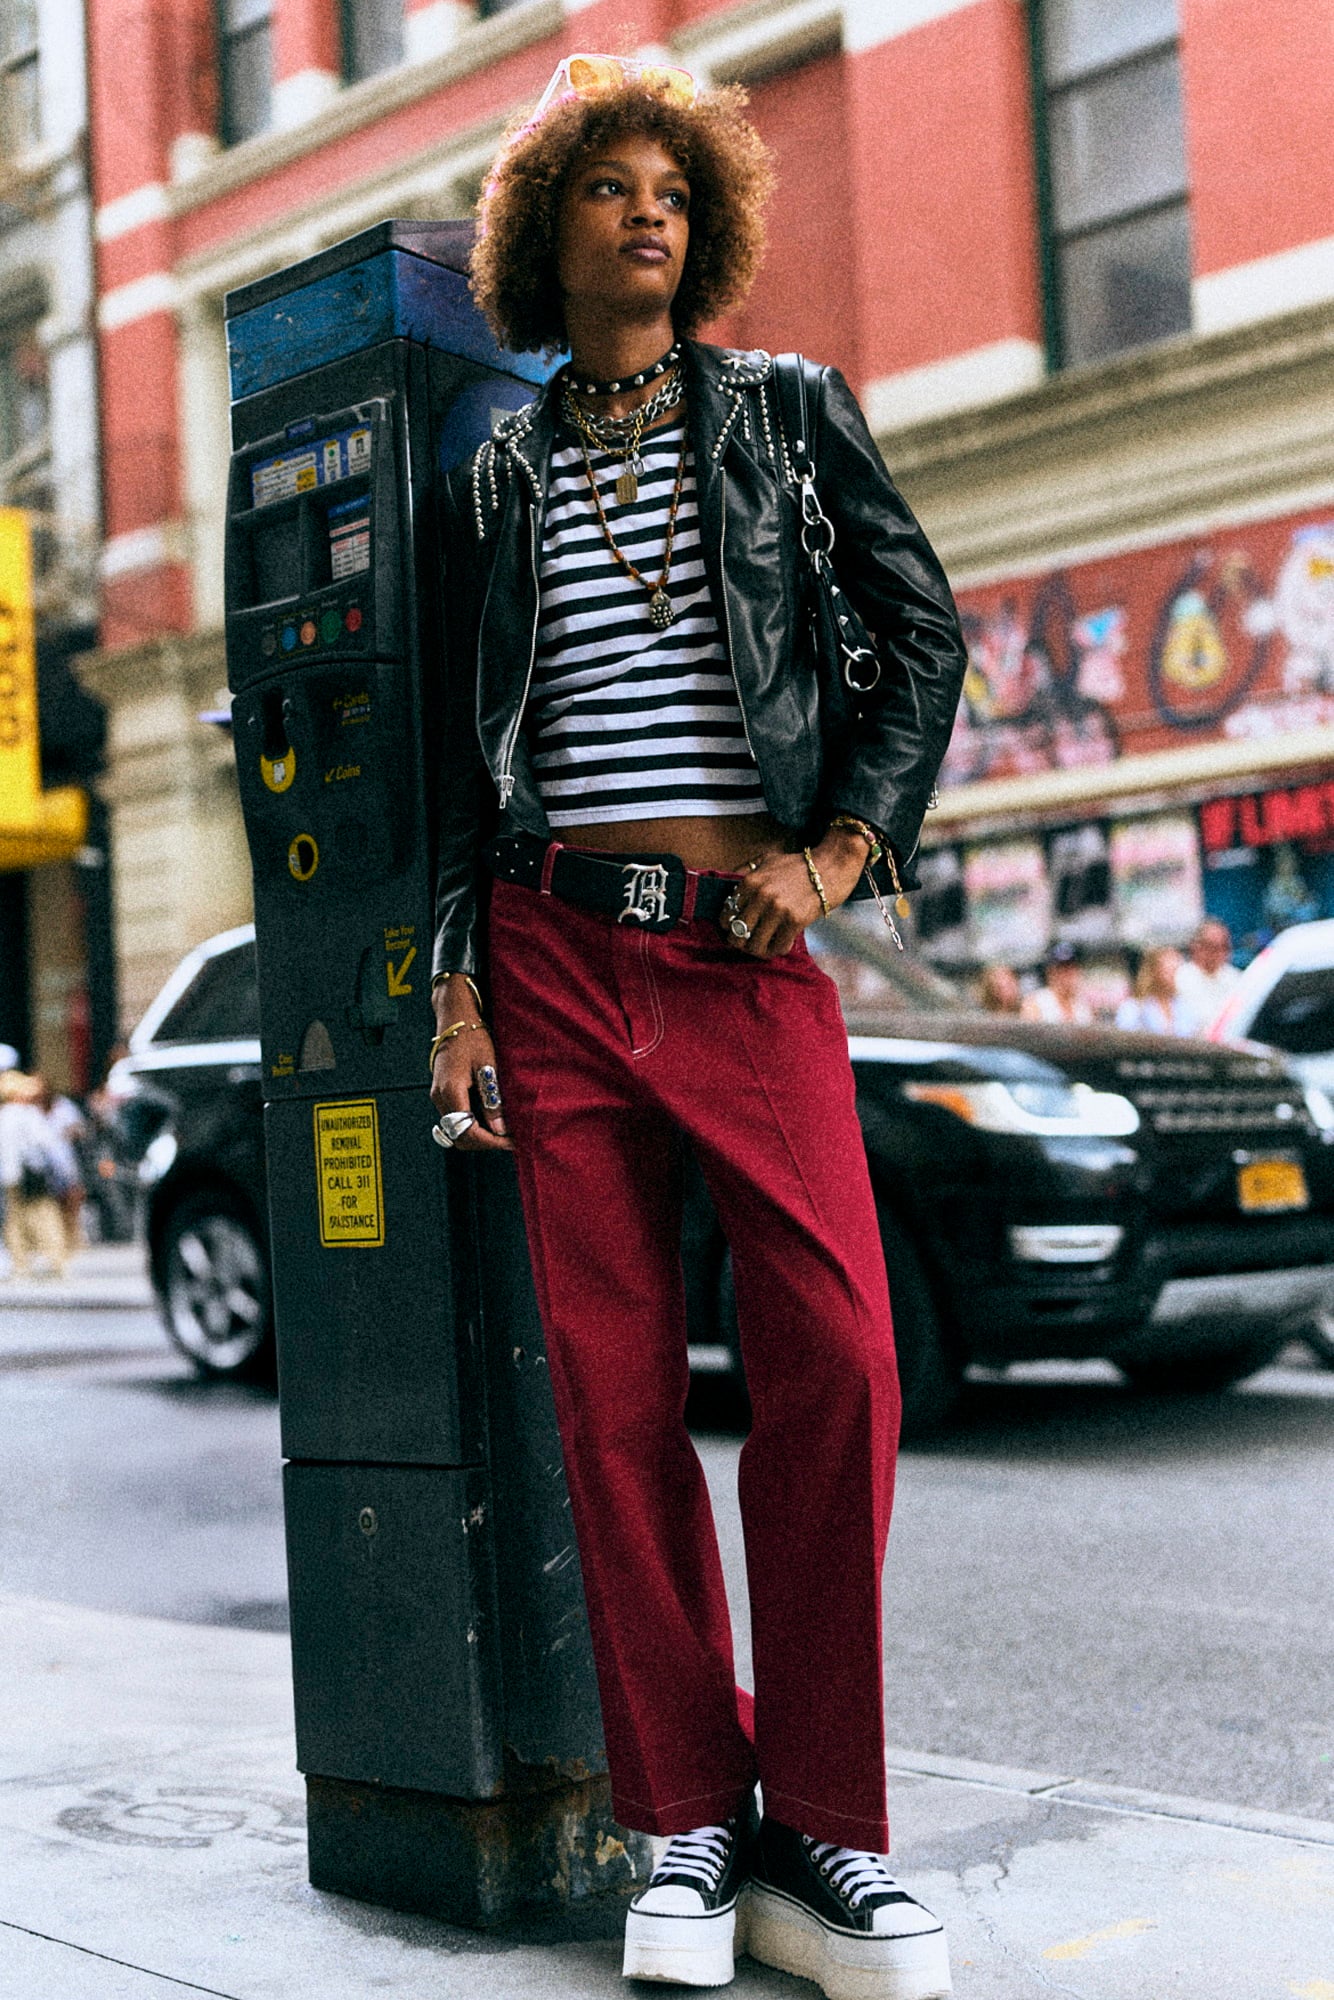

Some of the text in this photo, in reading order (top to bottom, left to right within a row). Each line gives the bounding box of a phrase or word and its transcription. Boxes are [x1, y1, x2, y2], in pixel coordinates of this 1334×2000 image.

[335, 764, 361, 781] Coins
[321, 1115, 371, 1131] UNAUTHORIZED
[331, 1135, 362, 1151] REMOVAL
[324, 1155, 372, 1171] PROHIBITED
[328, 1175, 370, 1190] CALL 311
[341, 1195, 358, 1210] FOR
